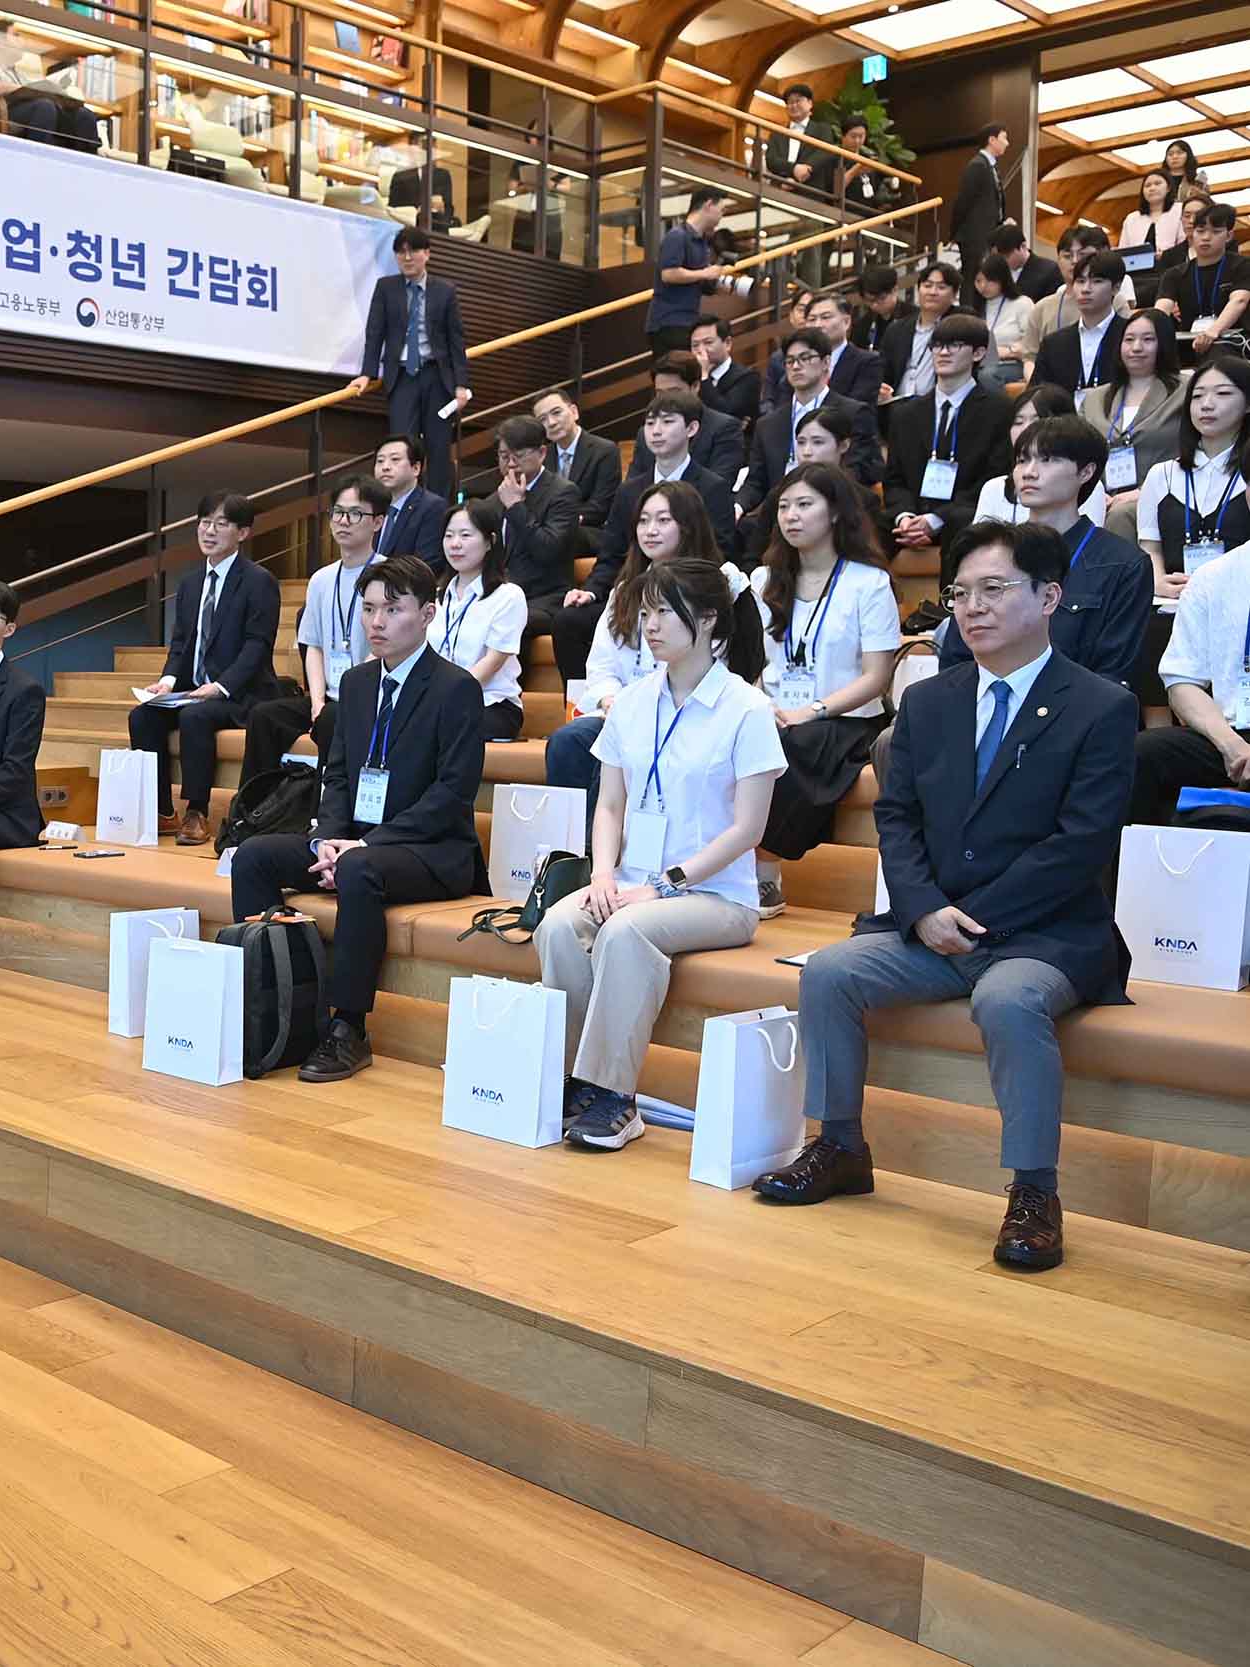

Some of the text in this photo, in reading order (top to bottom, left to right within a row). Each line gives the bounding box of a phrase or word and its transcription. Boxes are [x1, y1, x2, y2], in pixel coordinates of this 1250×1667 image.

[167, 247, 278, 312] 간담회
[104, 309, 166, 333] 산업통상부
[511, 869, 532, 880] KND
[1154, 937, 1198, 952] KNDA
[168, 1035, 194, 1049] KNDA
[472, 1085, 504, 1103] KNDA
